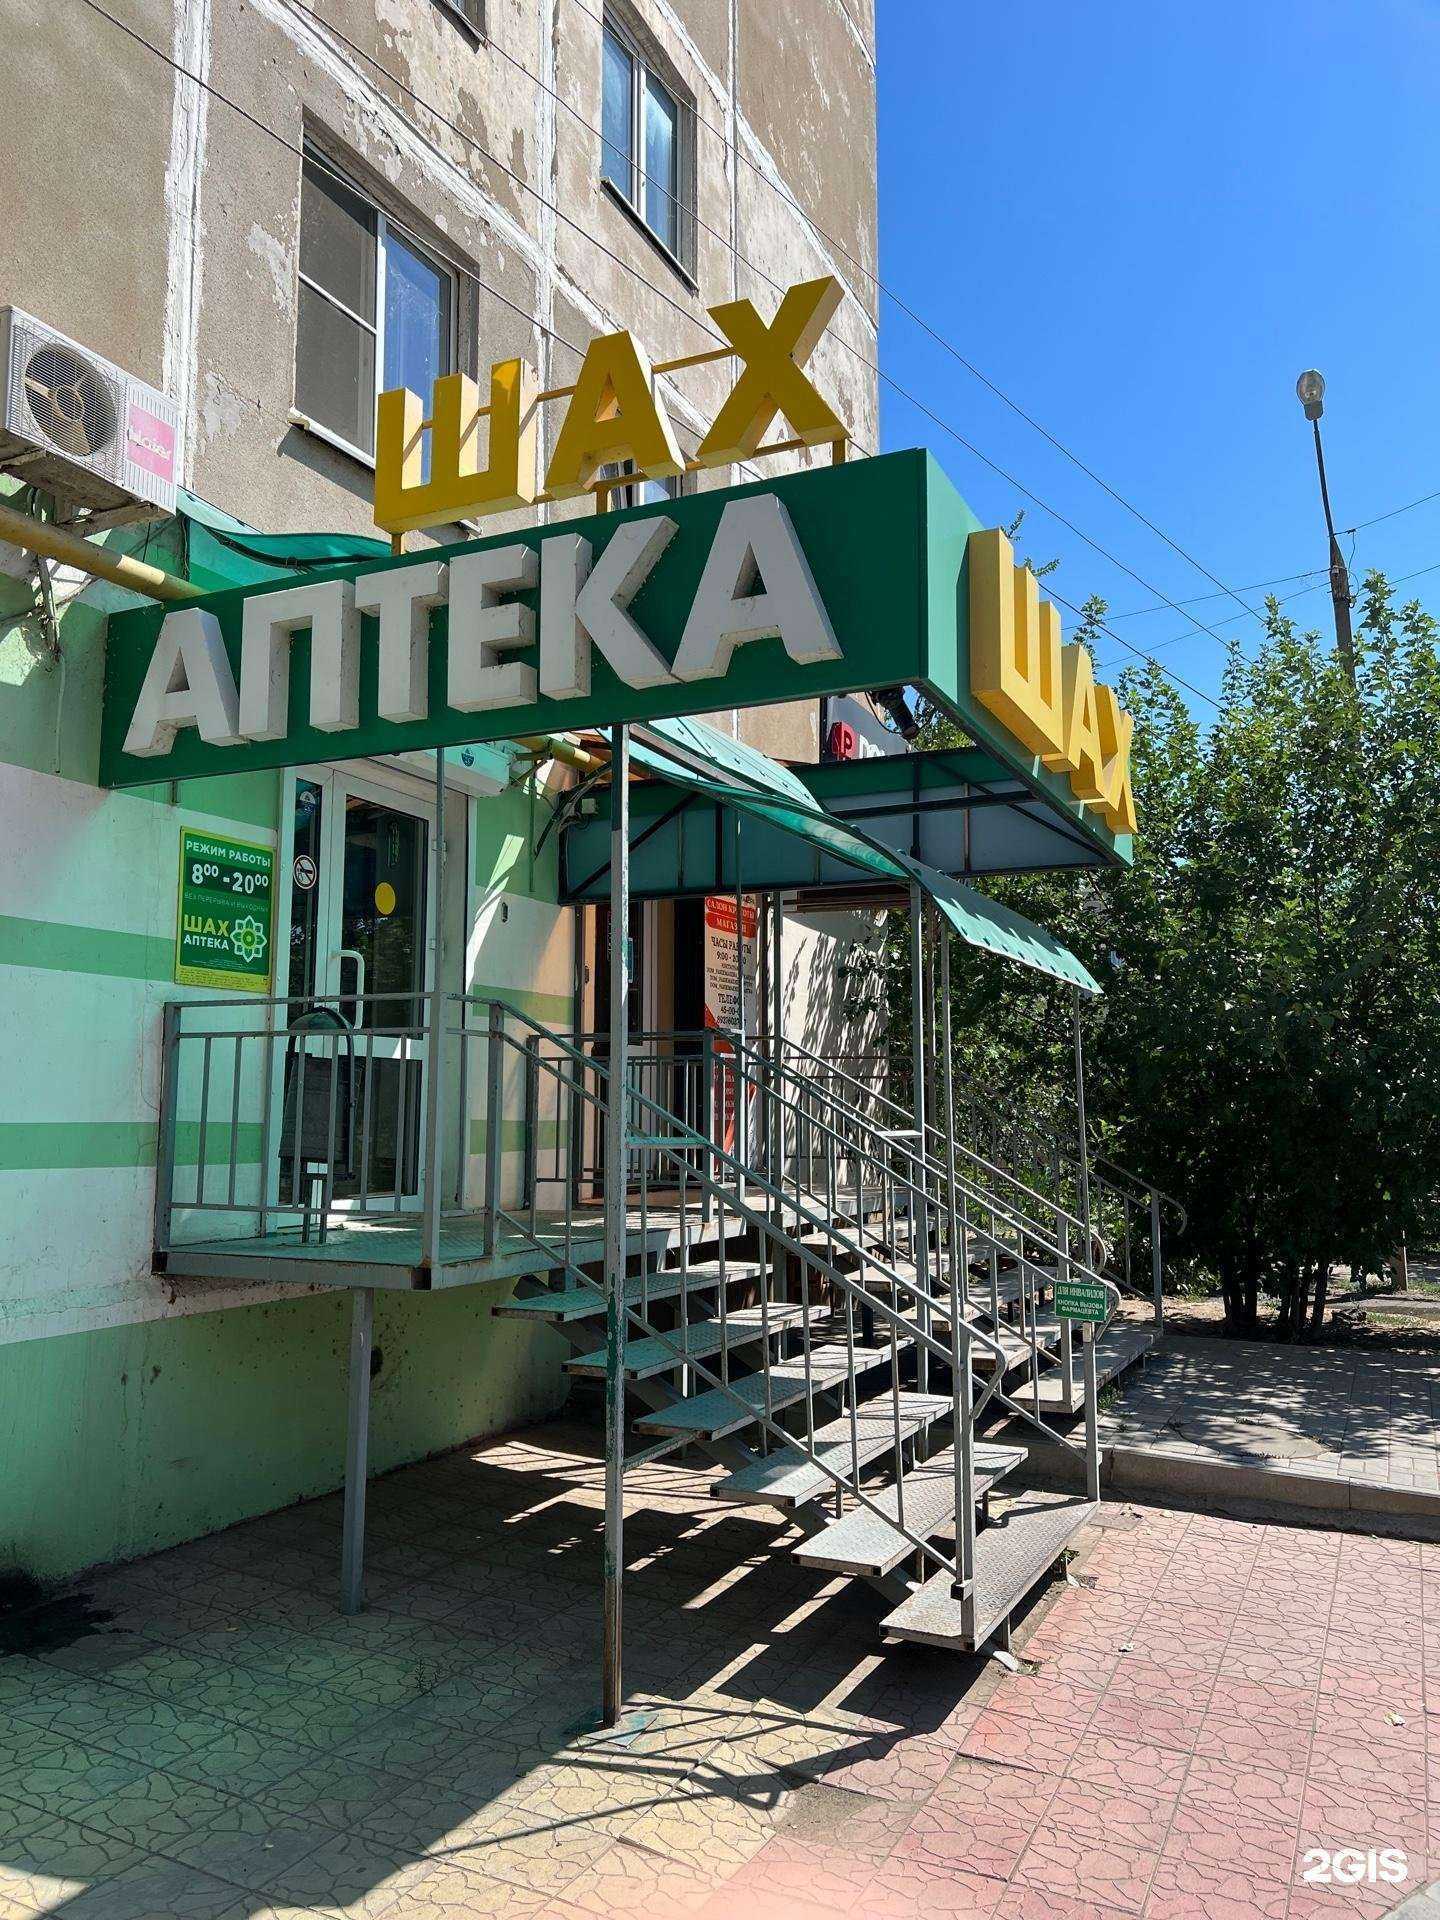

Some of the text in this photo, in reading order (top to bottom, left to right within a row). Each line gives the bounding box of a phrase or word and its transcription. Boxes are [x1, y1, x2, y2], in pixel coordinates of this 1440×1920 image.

[374, 275, 850, 534] ШАХ
[122, 493, 845, 758] АПТЕКА
[968, 527, 1139, 835] ШАХ
[185, 840, 271, 868] РЕЖИМ РАБОТЫ
[183, 914, 230, 937] ШАХ
[716, 917, 747, 933] МАГАЗН
[183, 934, 230, 951] АПТЕКА
[1056, 1299, 1104, 1309] КНОПКА ВЫЗОВА
[1057, 1286, 1104, 1299] ДЛЯ ИНВАЛИДОВ
